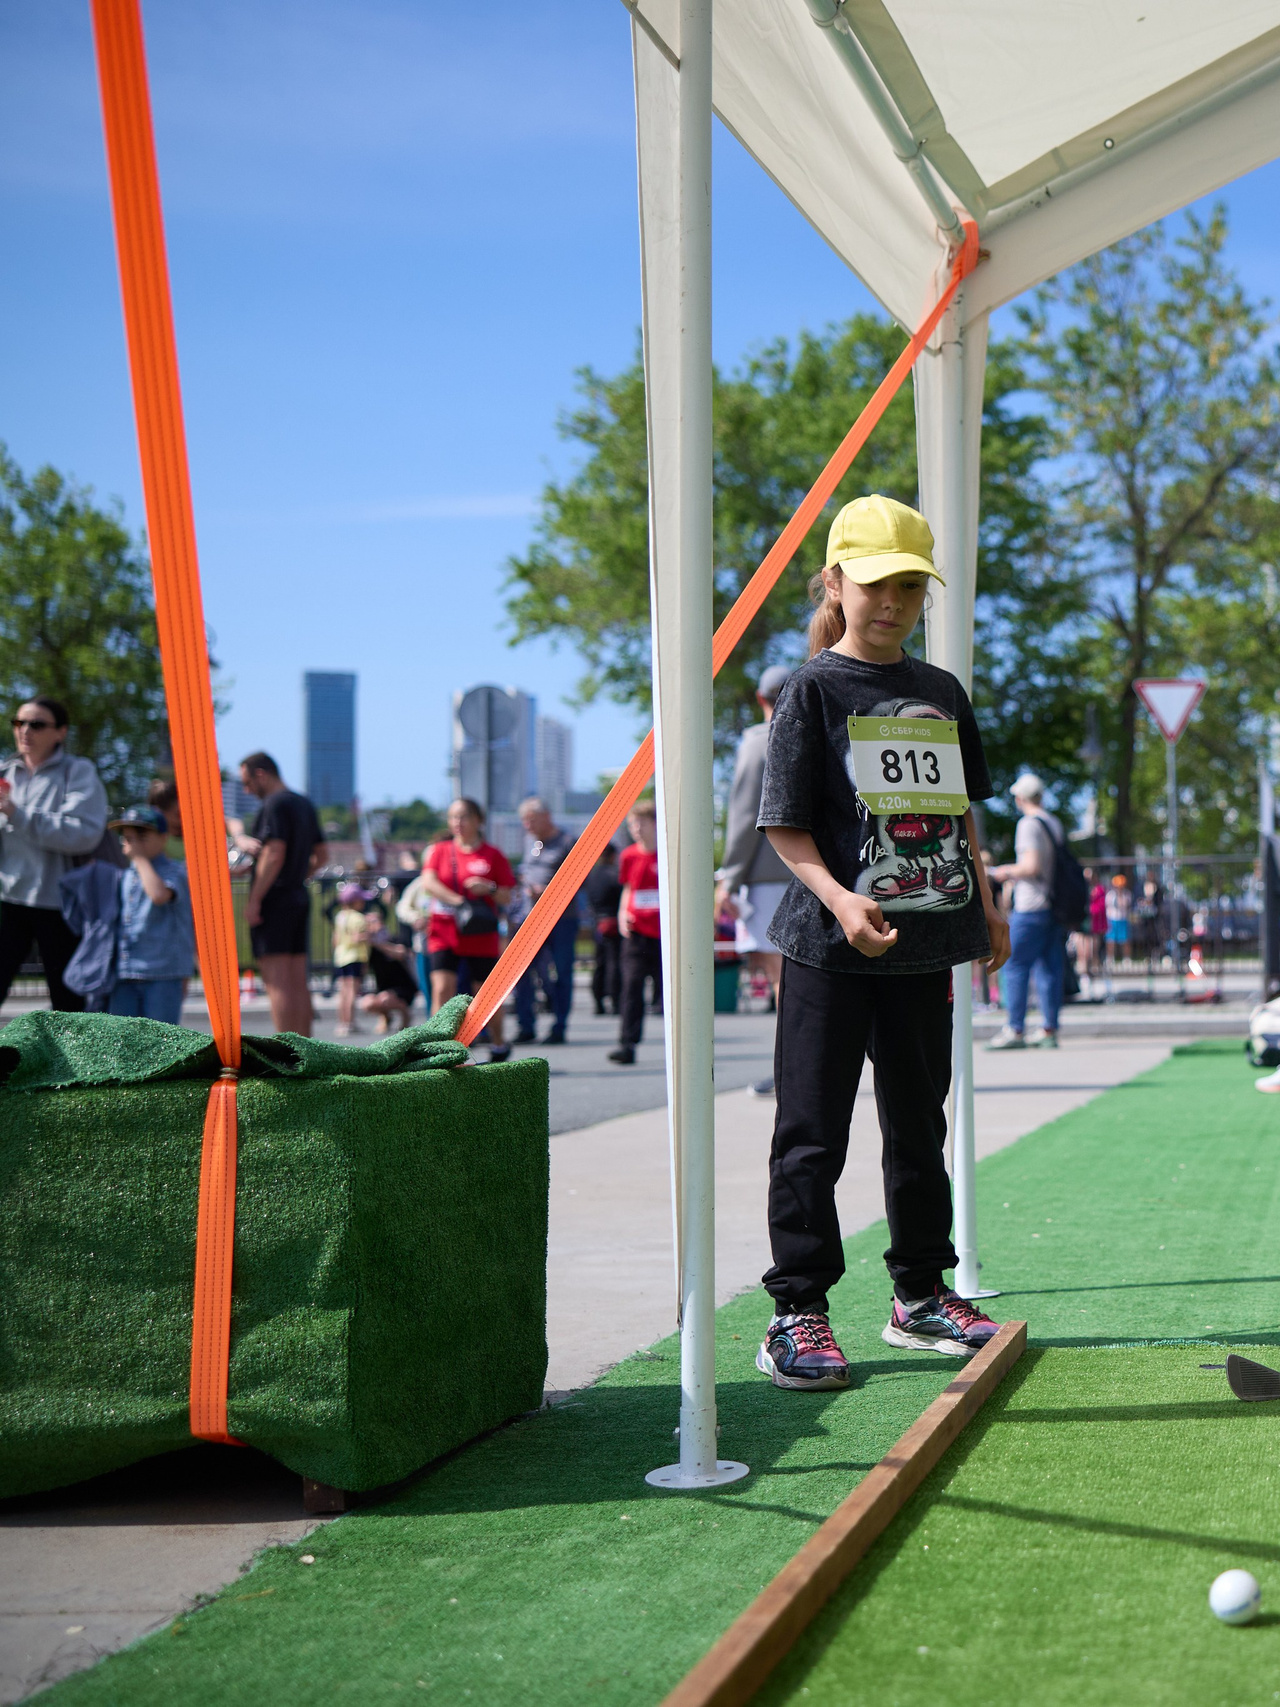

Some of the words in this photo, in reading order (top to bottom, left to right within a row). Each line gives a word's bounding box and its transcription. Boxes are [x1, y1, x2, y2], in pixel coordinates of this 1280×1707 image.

[891, 726, 914, 735] СБЕР
[914, 728, 931, 737] KIDS
[880, 749, 941, 785] 813
